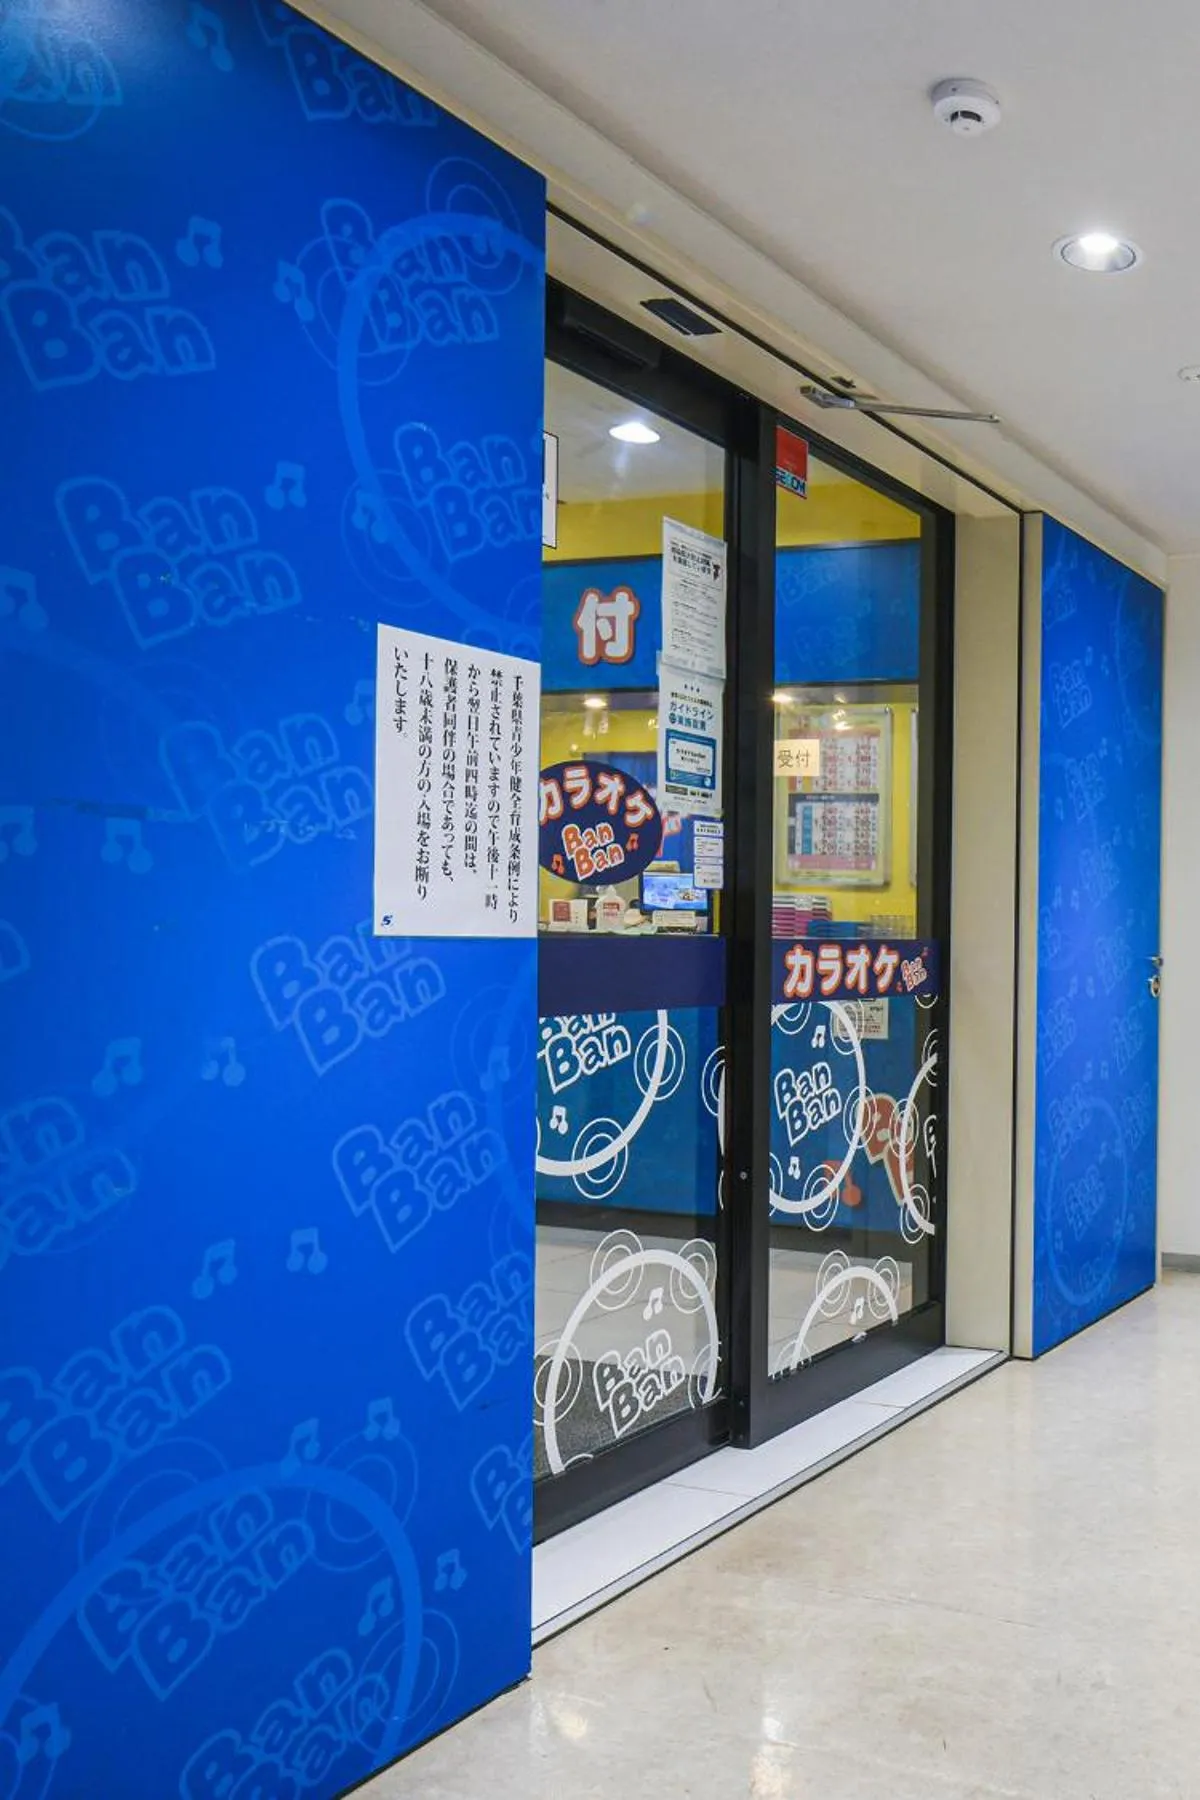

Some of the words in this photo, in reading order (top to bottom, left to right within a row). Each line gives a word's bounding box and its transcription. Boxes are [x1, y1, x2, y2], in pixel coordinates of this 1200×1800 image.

[3, 280, 217, 392] Ban
[54, 474, 260, 585] Ban
[110, 549, 303, 650] Ban
[576, 587, 639, 665] 付
[778, 750, 810, 769] 受付
[562, 822, 615, 860] Ban
[574, 843, 625, 881] Ban
[783, 944, 899, 998] カラオケ
[292, 957, 447, 1078] Ban
[545, 1025, 632, 1094] Ban
[774, 1061, 832, 1120] Ban
[786, 1087, 842, 1147] Ban
[592, 1328, 672, 1412] Ban
[610, 1355, 685, 1438] Ban
[19, 1343, 232, 1524] Ban
[131, 1519, 316, 1701] Ban
